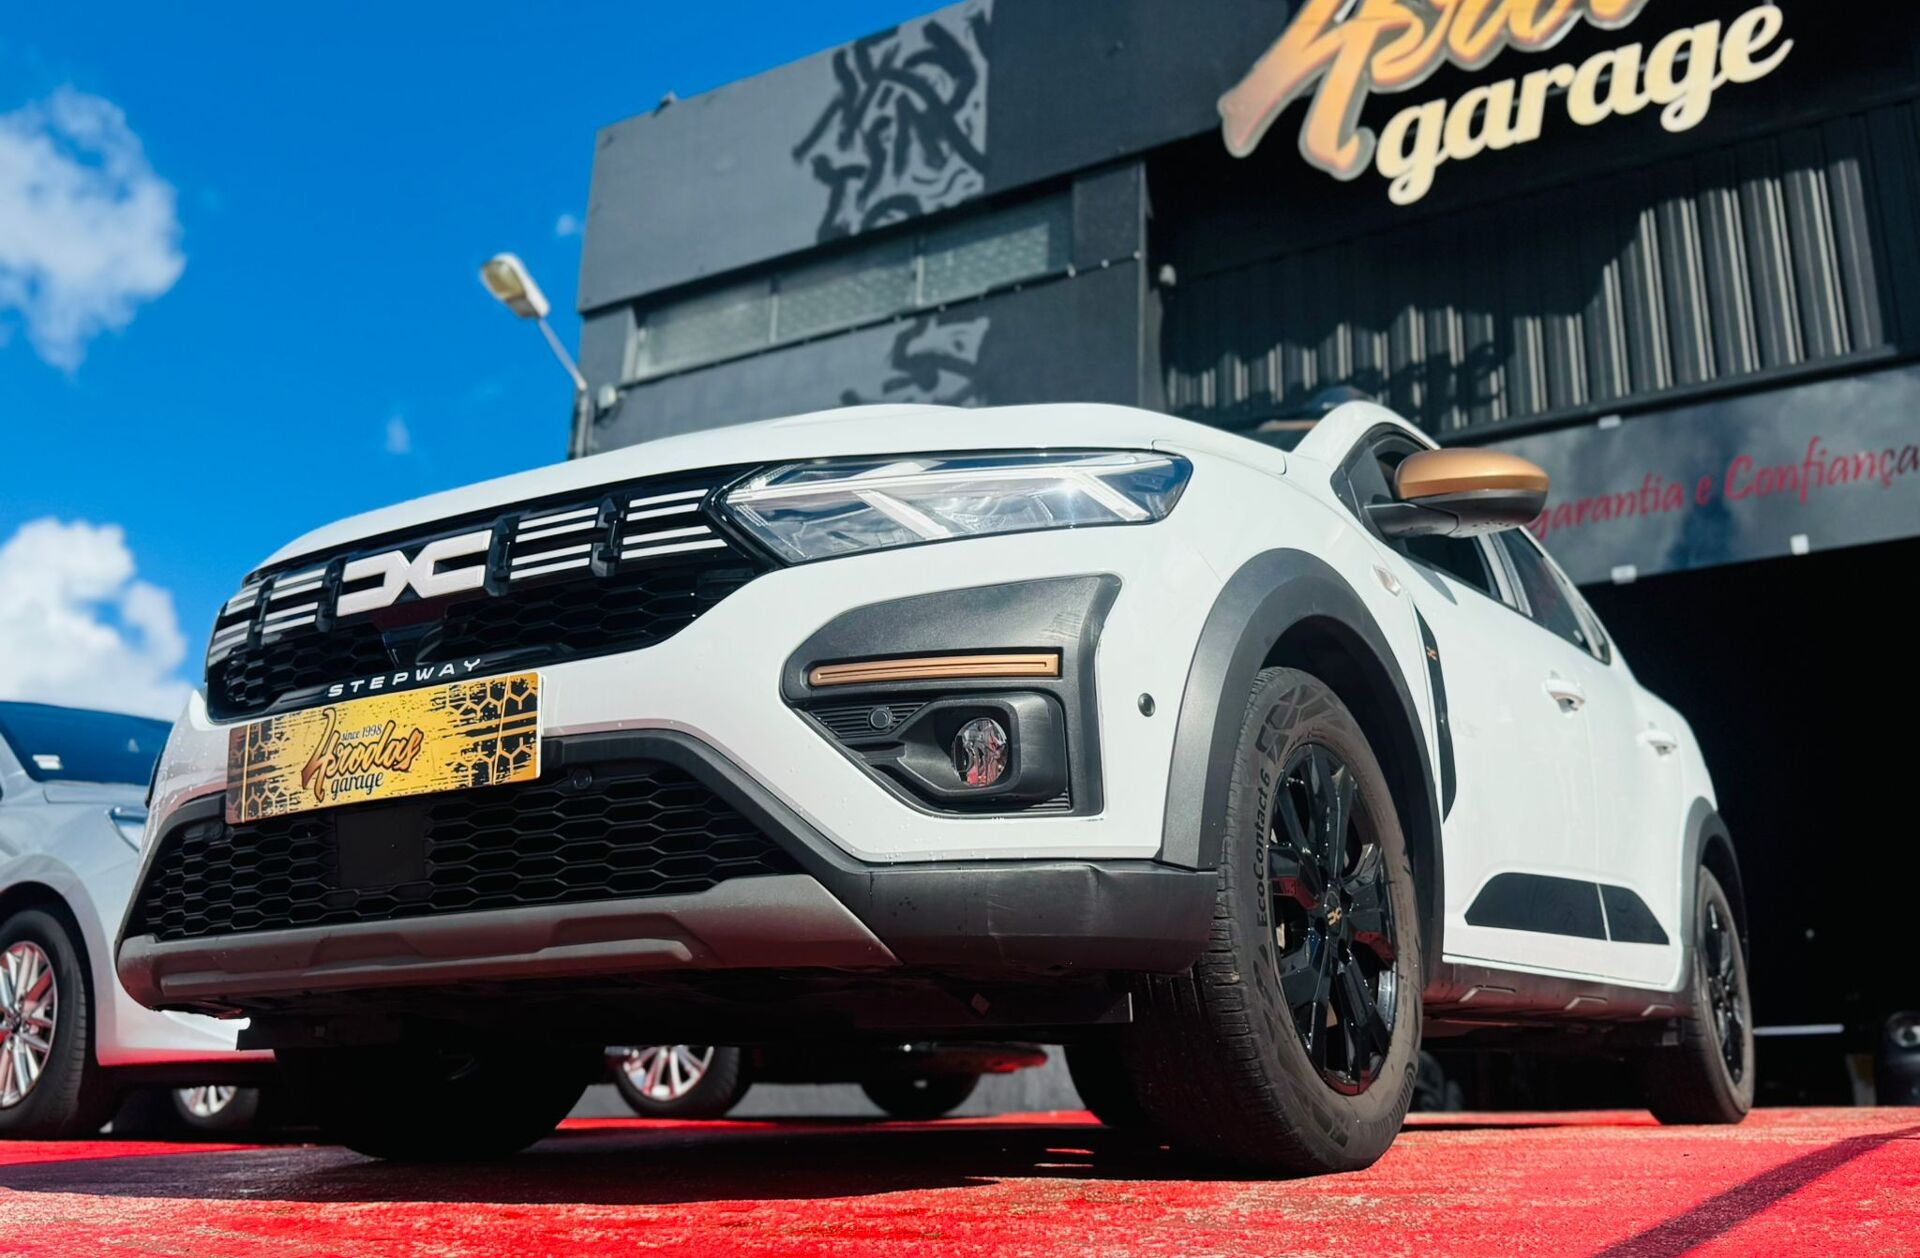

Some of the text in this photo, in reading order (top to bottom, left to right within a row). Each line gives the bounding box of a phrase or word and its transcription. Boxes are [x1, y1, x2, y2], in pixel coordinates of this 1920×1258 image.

[1376, 4, 1794, 205] garage
[1698, 475, 1712, 505] e
[1724, 435, 1920, 504] Confiança
[328, 658, 481, 698] STEPWAY
[341, 723, 383, 741] since 1998
[330, 771, 385, 801] garage
[1253, 768, 1271, 927] EcoContact 6
